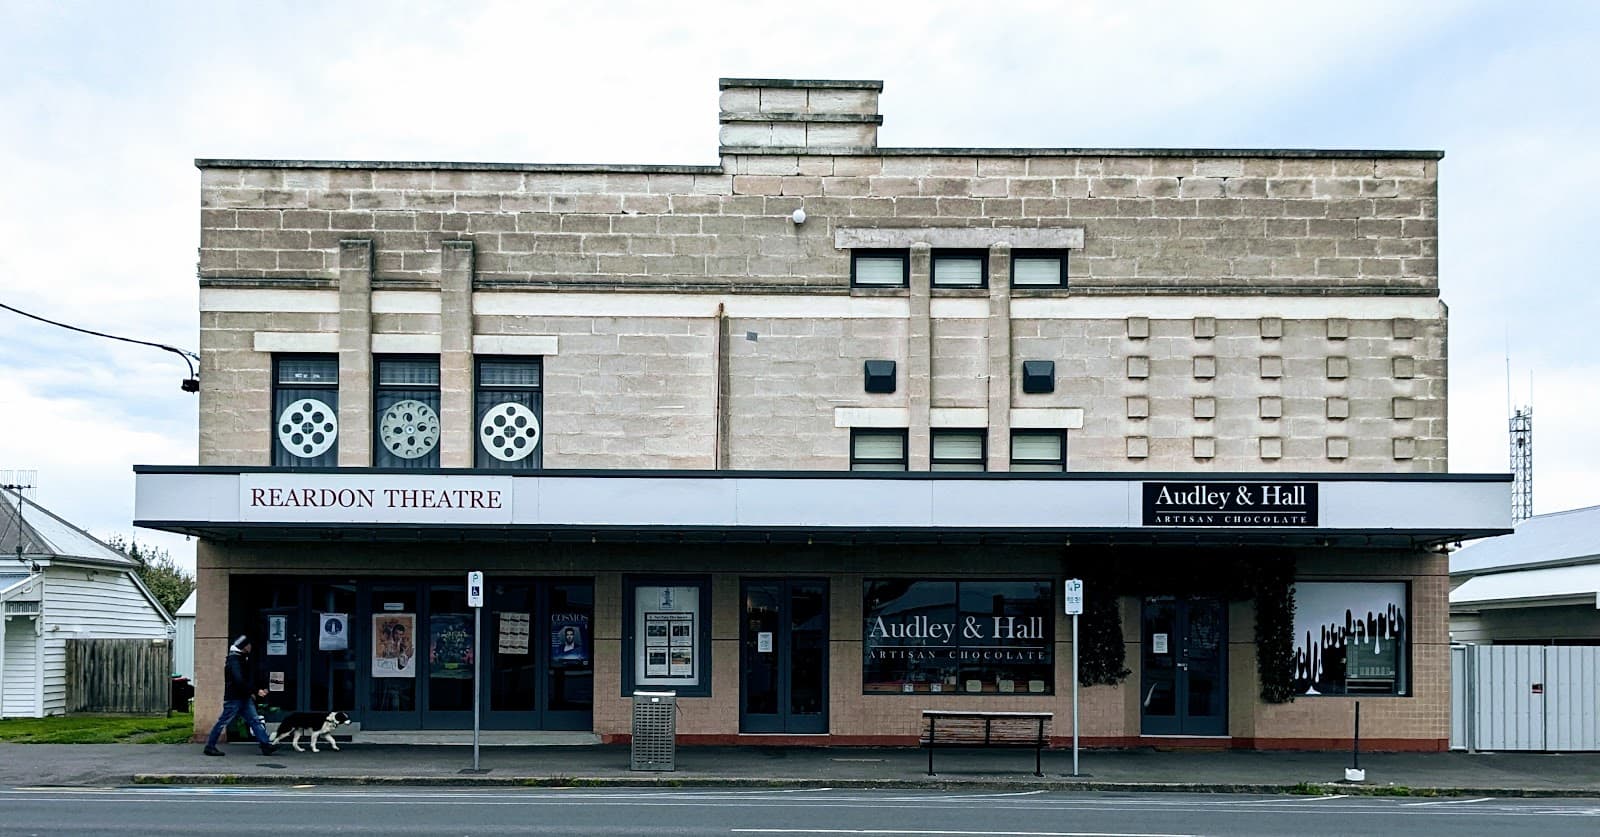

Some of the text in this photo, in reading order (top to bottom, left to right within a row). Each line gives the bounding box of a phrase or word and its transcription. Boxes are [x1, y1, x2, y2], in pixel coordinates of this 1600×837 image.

[251, 487, 502, 509] REARDON THEATRE
[1155, 485, 1306, 509] Audley & Hall
[1155, 515, 1307, 524] ARTISAN CHOCOLATE
[869, 615, 1045, 643] Audley & Hall
[868, 650, 1046, 660] ARTISAN CHOCOLATE
